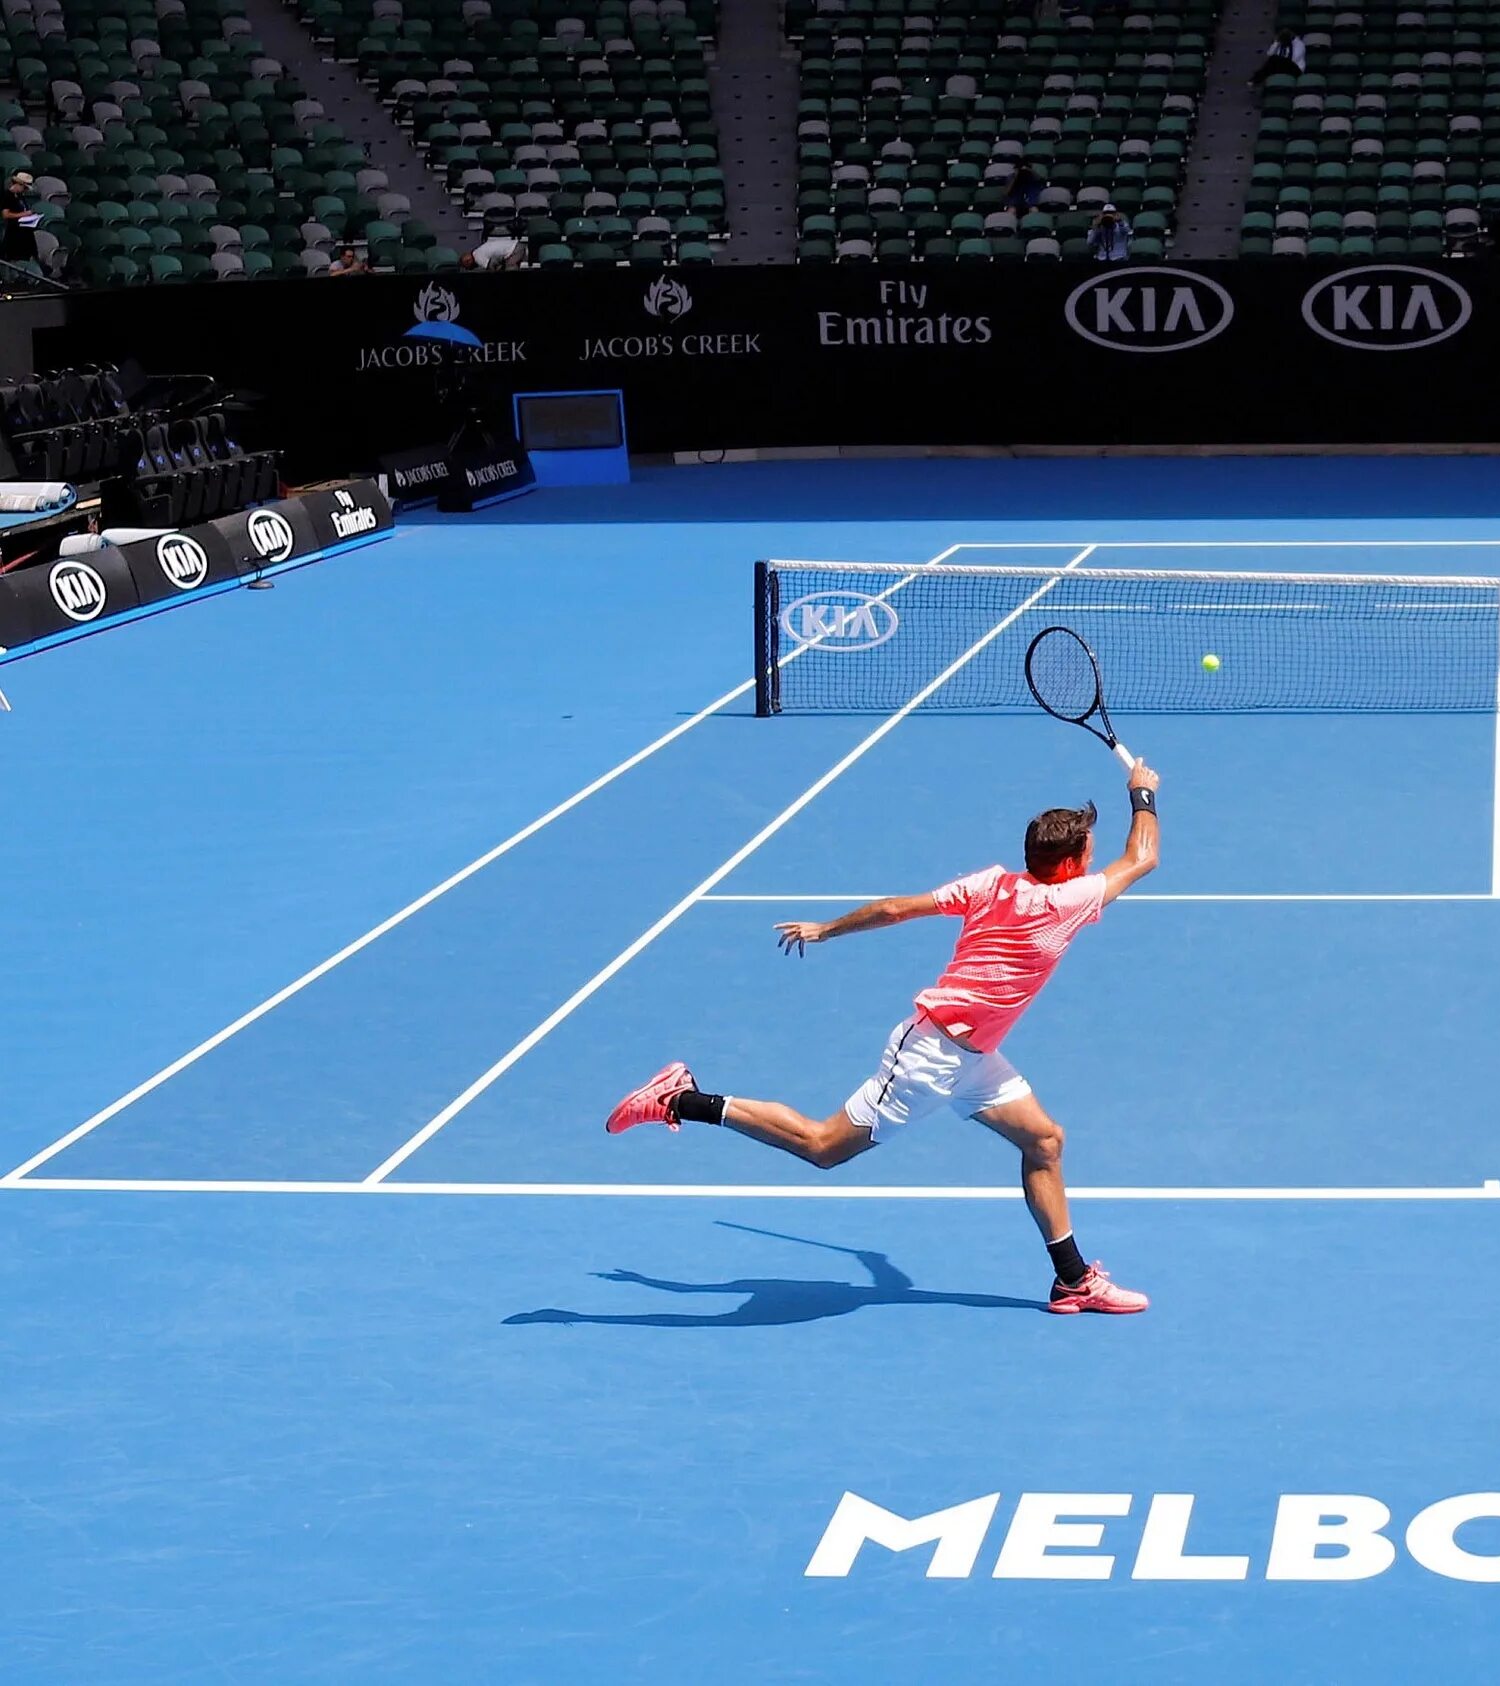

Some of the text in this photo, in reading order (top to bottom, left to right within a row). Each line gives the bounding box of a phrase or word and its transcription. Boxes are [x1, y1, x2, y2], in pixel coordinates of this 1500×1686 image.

[880, 280, 928, 310] Fly
[1095, 287, 1206, 333] KIA
[1332, 284, 1444, 331] KIA
[817, 304, 993, 346] Emirates
[356, 341, 527, 371] JACOB'S REEK
[579, 333, 762, 361] JACOB'S CREEK
[253, 517, 288, 554] KIA
[163, 543, 203, 579] KIA
[56, 570, 101, 611] KIA
[802, 603, 879, 639] KIA
